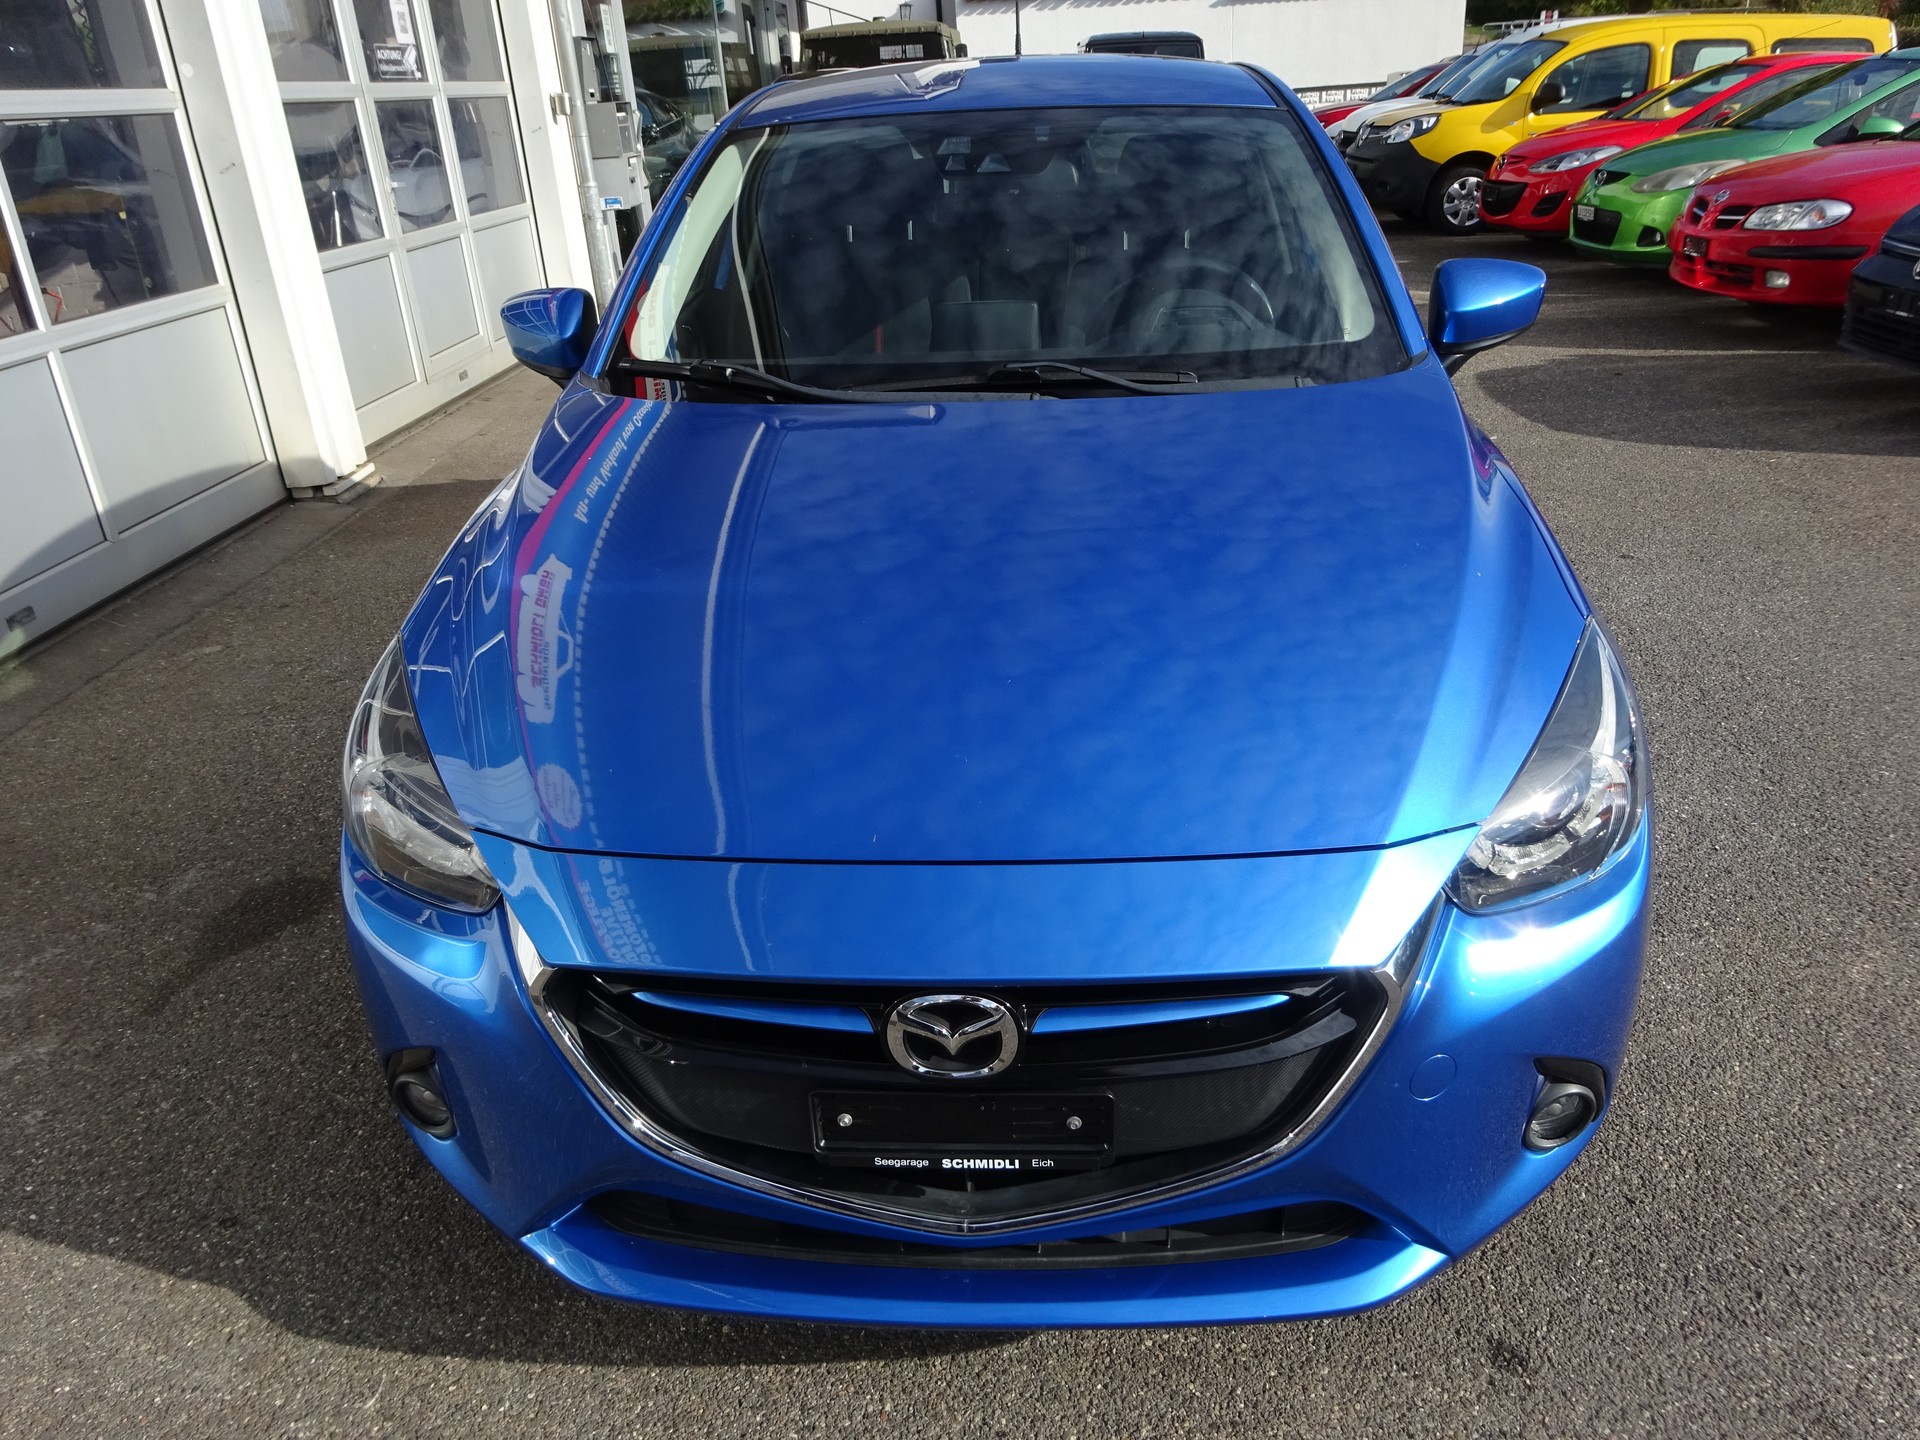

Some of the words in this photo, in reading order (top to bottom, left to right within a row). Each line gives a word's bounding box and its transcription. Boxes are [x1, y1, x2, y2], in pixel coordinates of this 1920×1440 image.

[874, 1156, 929, 1168] Seegarage
[941, 1158, 1020, 1169] SCHMIDLI
[1031, 1158, 1054, 1168] Eich
